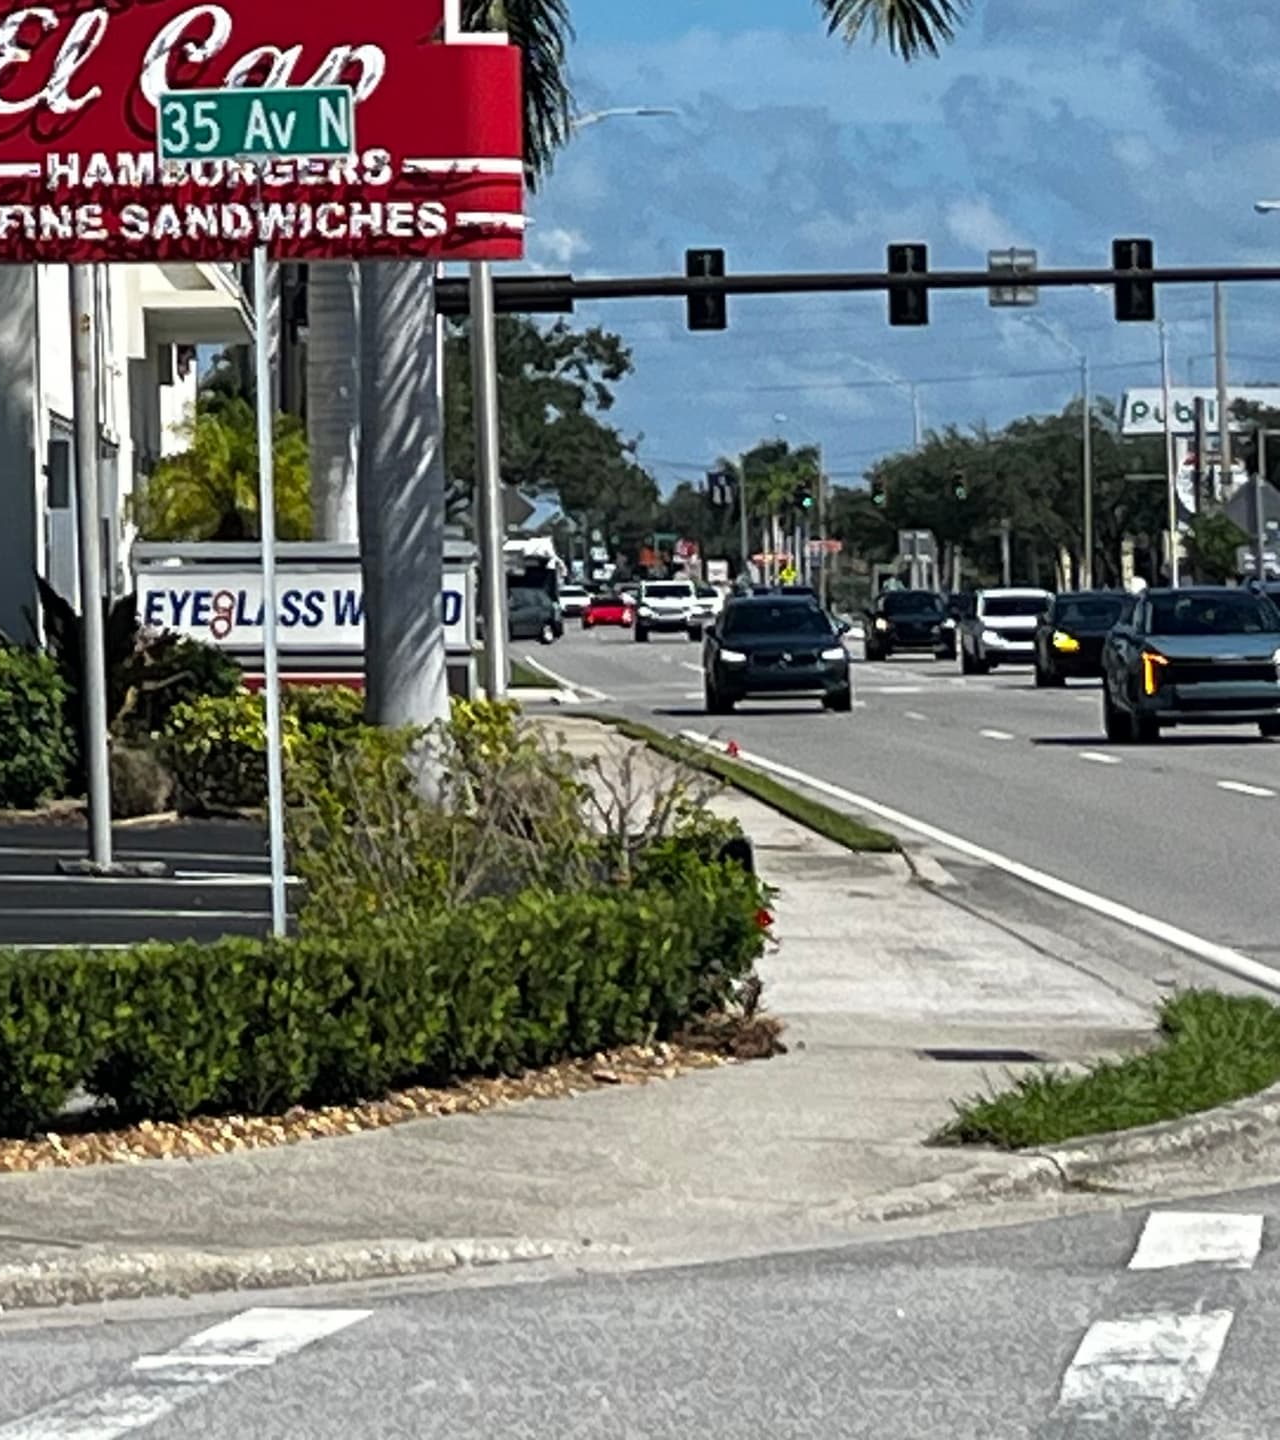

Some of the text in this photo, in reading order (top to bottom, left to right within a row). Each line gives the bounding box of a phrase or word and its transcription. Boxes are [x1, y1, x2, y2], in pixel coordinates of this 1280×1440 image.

[162, 96, 349, 152] 35 Av N
[46, 148, 392, 188] HAMBURGERS
[119, 201, 448, 240] SANDWICHES
